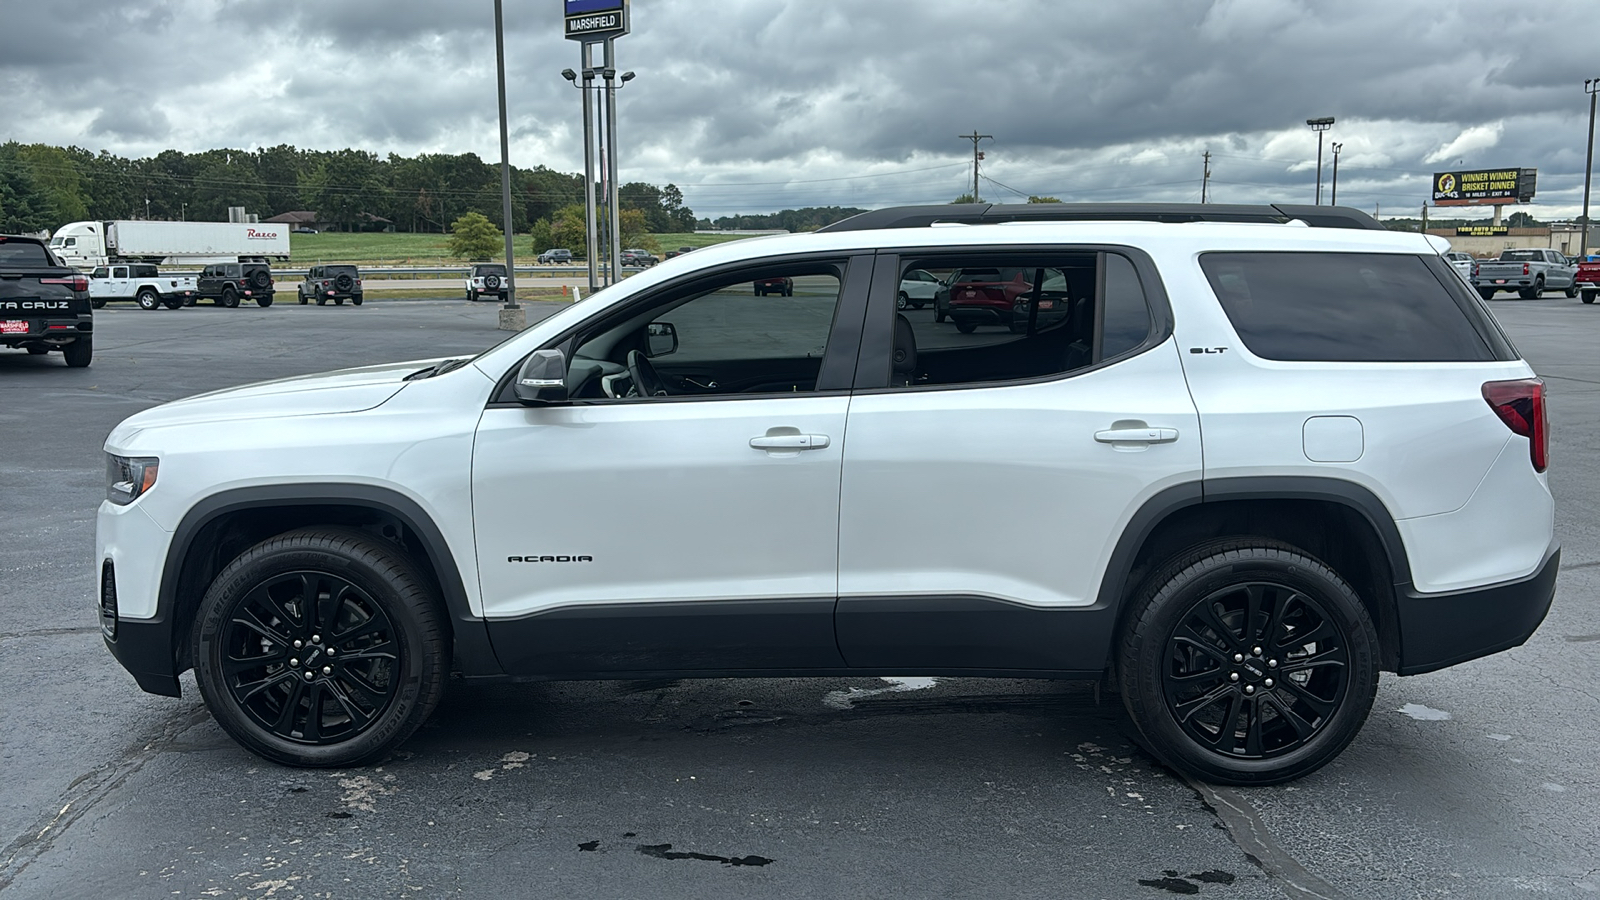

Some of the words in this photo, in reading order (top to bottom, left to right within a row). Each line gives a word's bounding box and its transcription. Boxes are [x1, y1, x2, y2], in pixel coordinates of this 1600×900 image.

[570, 15, 615, 31] MARSHFIELD
[1461, 173, 1488, 182] WINNER
[1489, 171, 1517, 180] WINNER
[1461, 182, 1488, 192] BRISKET
[1489, 181, 1515, 190] DINNER
[247, 228, 277, 238] Razco
[21, 301, 69, 309] CRUZ
[507, 555, 593, 563] ACADIA
